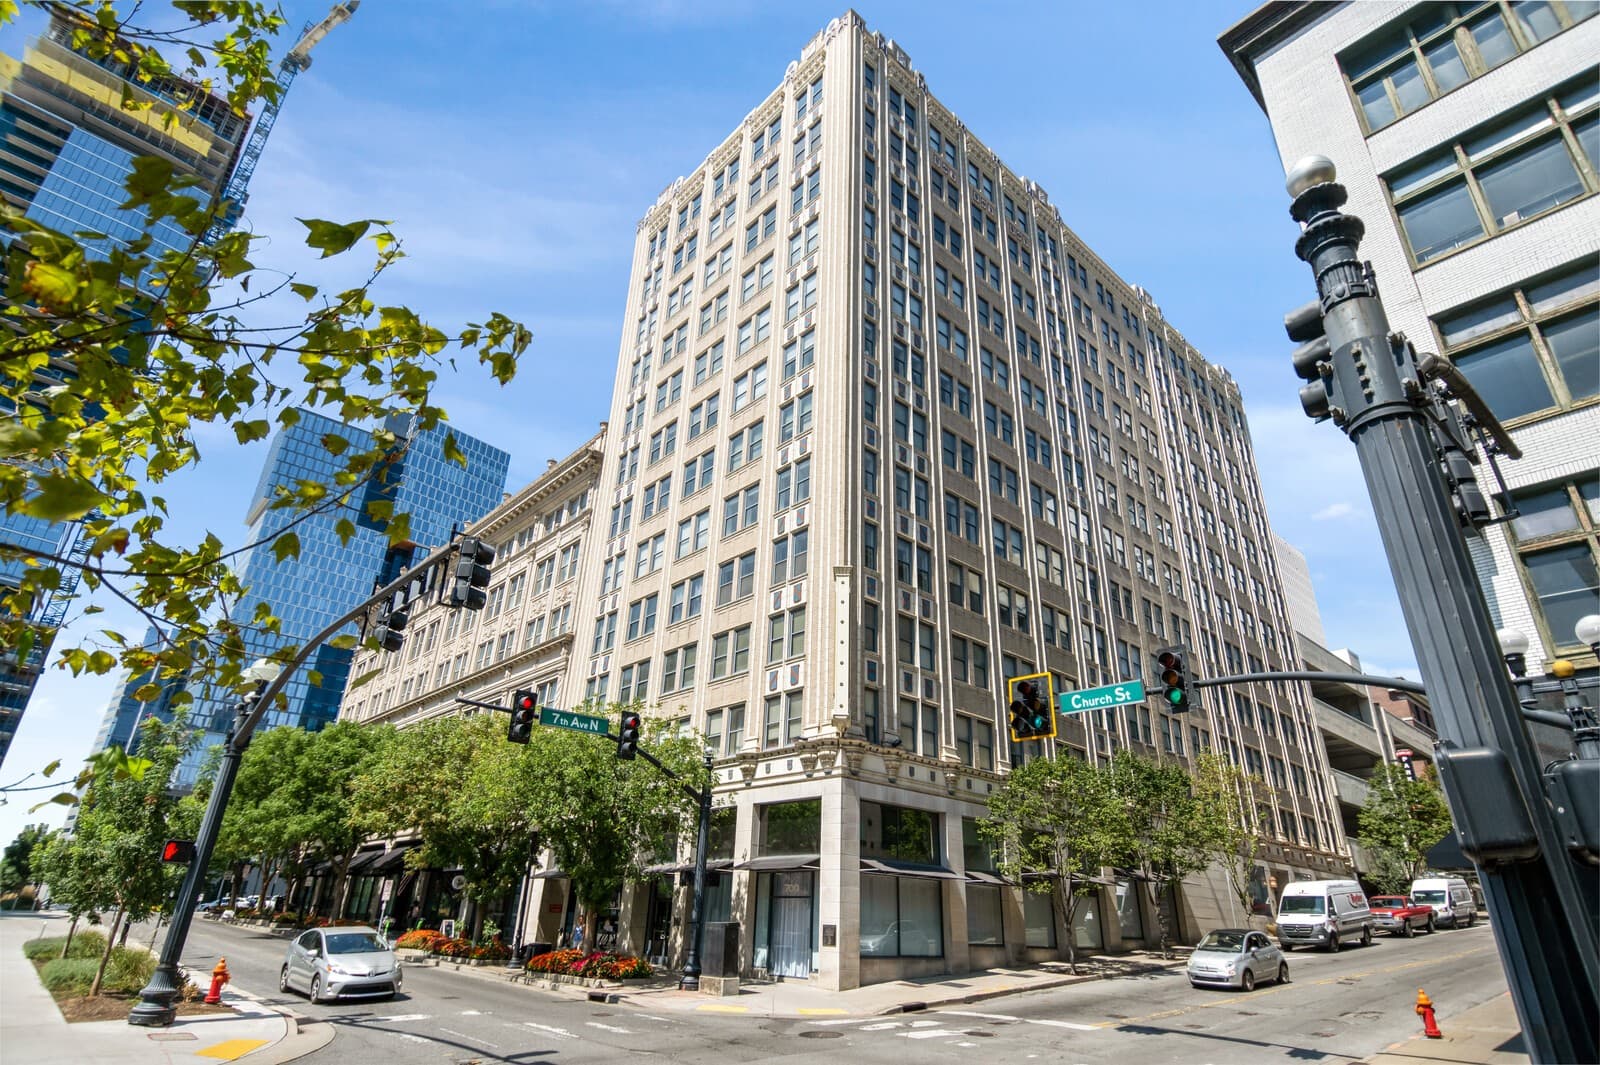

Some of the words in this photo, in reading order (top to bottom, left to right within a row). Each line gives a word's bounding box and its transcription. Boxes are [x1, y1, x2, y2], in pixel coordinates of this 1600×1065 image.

[1071, 694, 1113, 708] Church
[1114, 687, 1132, 702] St
[552, 713, 569, 726] 7th
[570, 716, 589, 730] Ave
[589, 719, 599, 731] N
